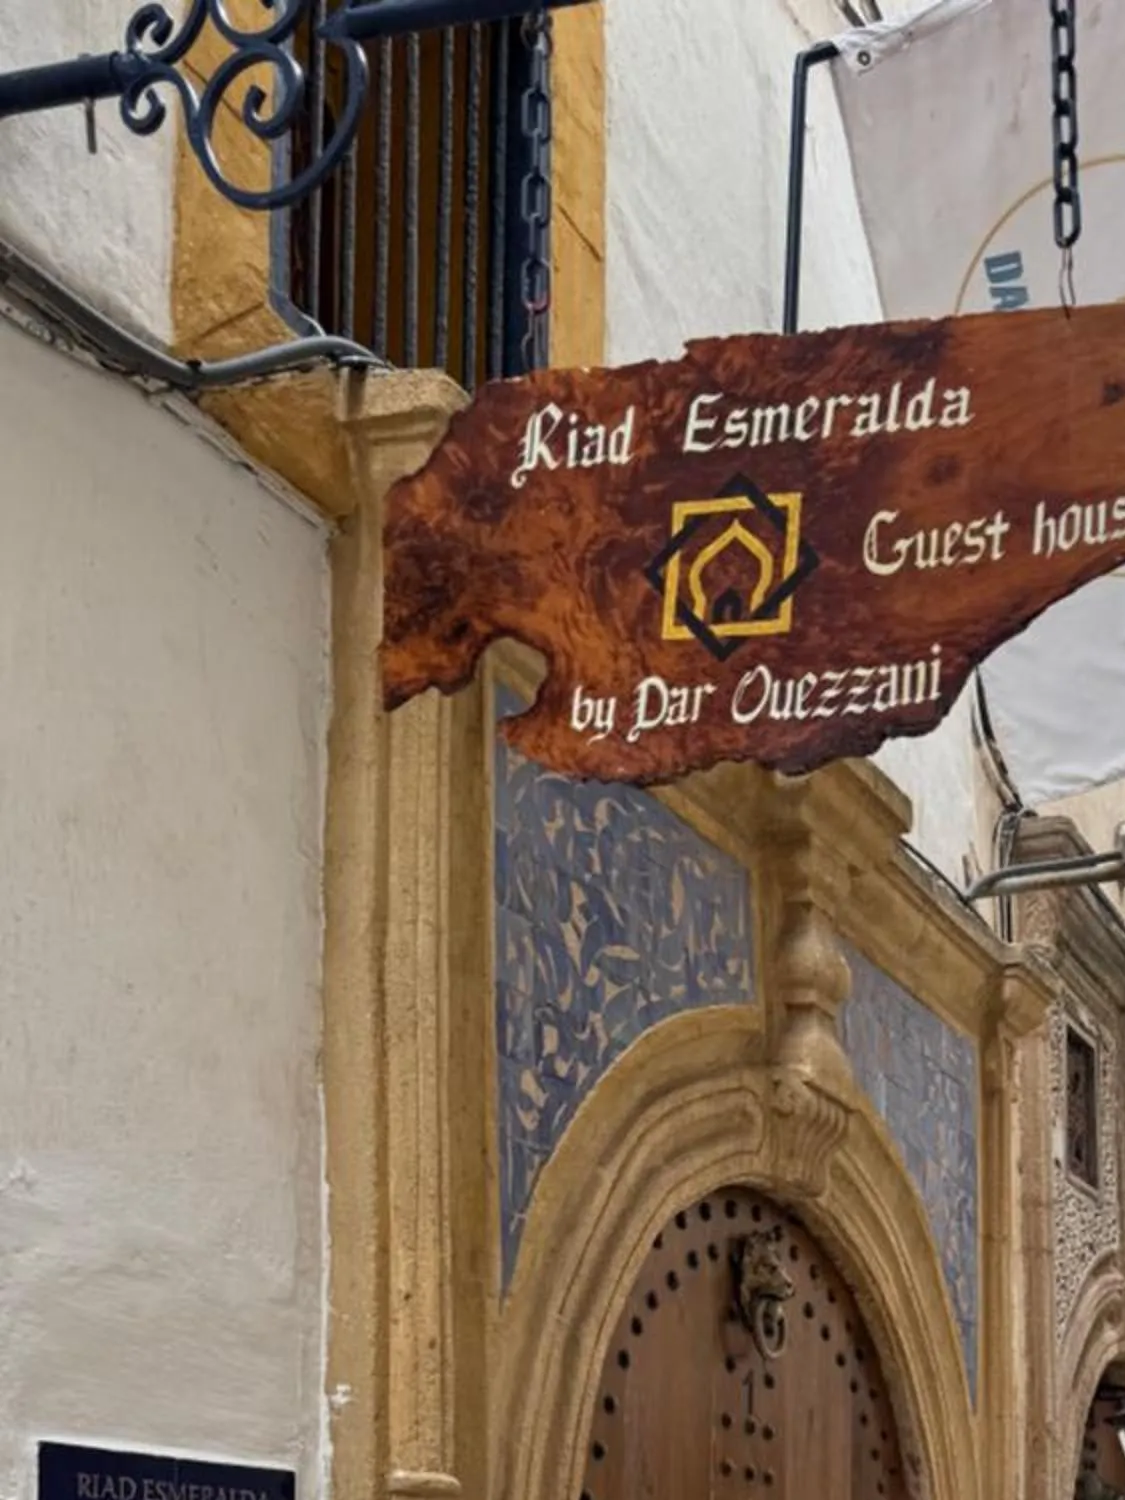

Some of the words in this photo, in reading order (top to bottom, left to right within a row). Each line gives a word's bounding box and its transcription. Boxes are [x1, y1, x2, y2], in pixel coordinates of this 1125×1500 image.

[510, 402, 634, 488] Riad
[683, 378, 973, 454] Esmeralda
[863, 508, 1009, 574] Guest
[570, 683, 616, 743] by
[627, 675, 715, 743] Dar
[730, 643, 942, 725] Ouezzani
[77, 1472, 137, 1500] RIAD
